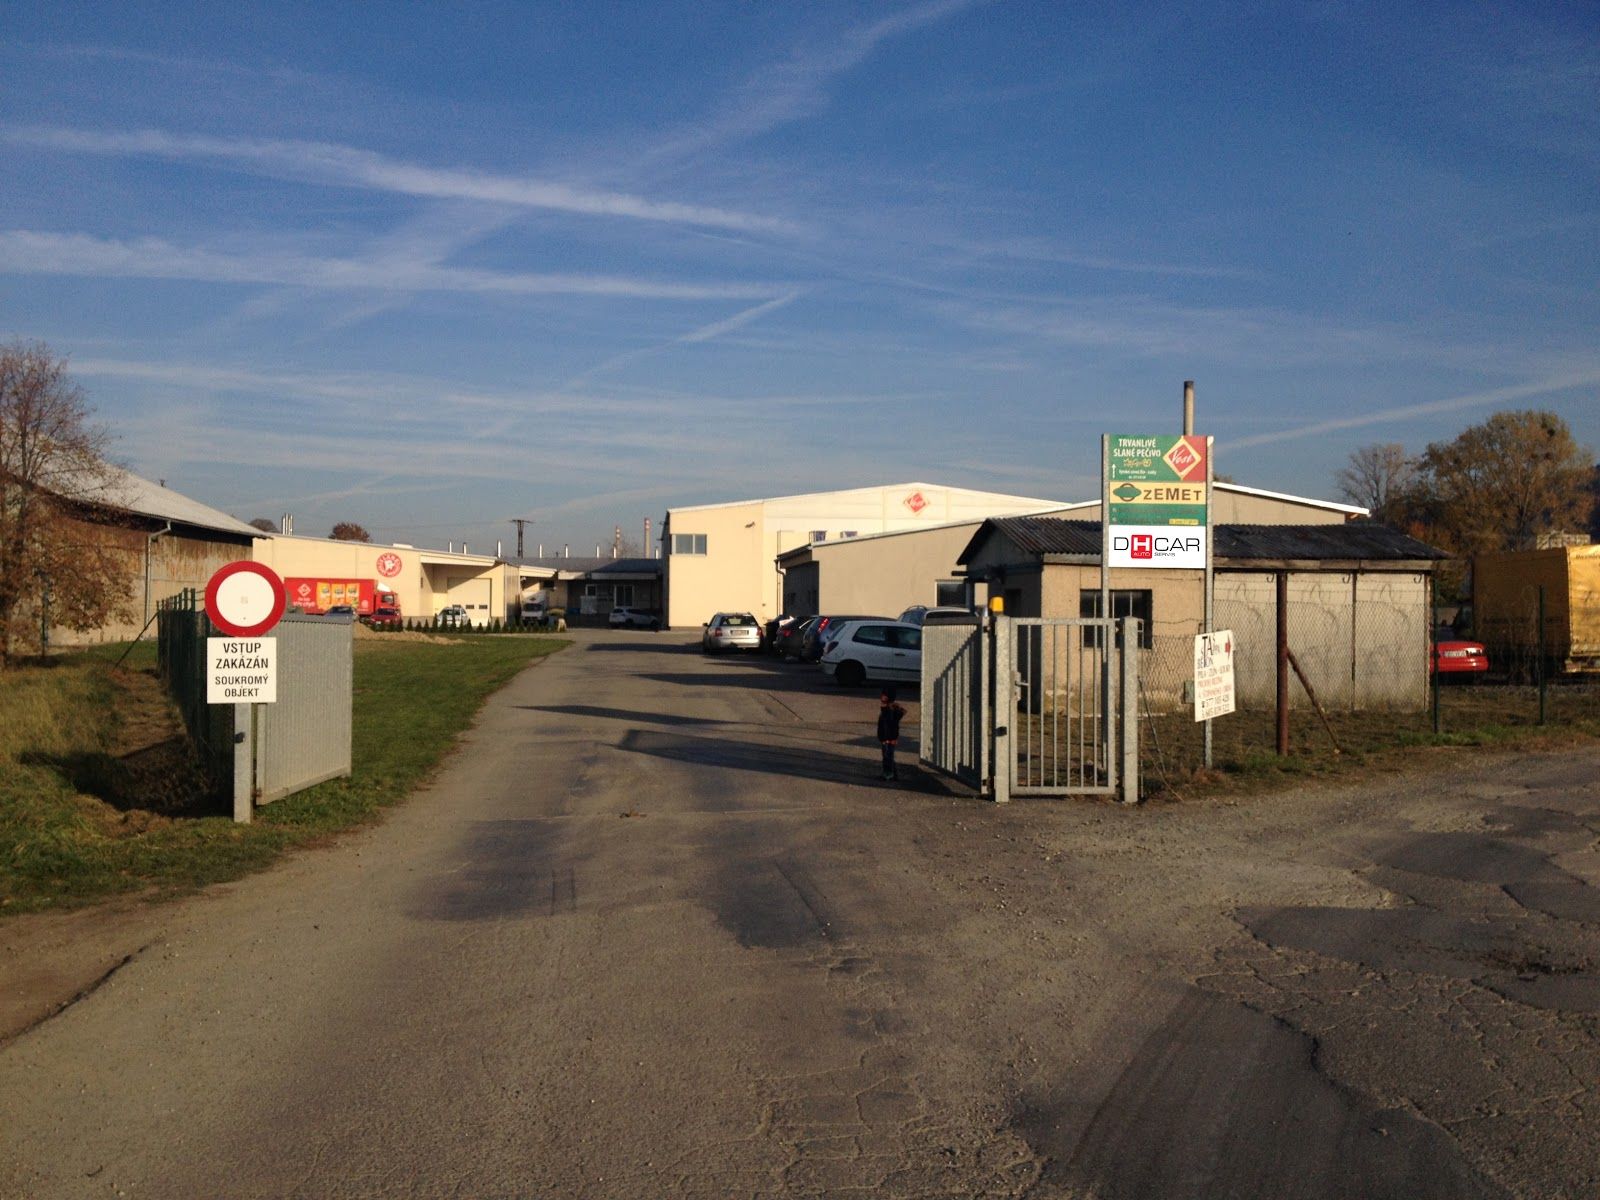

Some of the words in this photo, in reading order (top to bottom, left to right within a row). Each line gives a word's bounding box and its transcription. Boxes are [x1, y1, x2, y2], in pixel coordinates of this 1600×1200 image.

[1113, 447, 1135, 457] SLANÉ
[1136, 447, 1161, 457] PEČIVO
[1143, 487, 1202, 501] ZEMET
[223, 642, 262, 654] VSTUP
[215, 655, 269, 669] ZAKÁZÁN
[215, 673, 269, 686] SOUKROMÝ
[224, 687, 260, 698] OBJEKT
